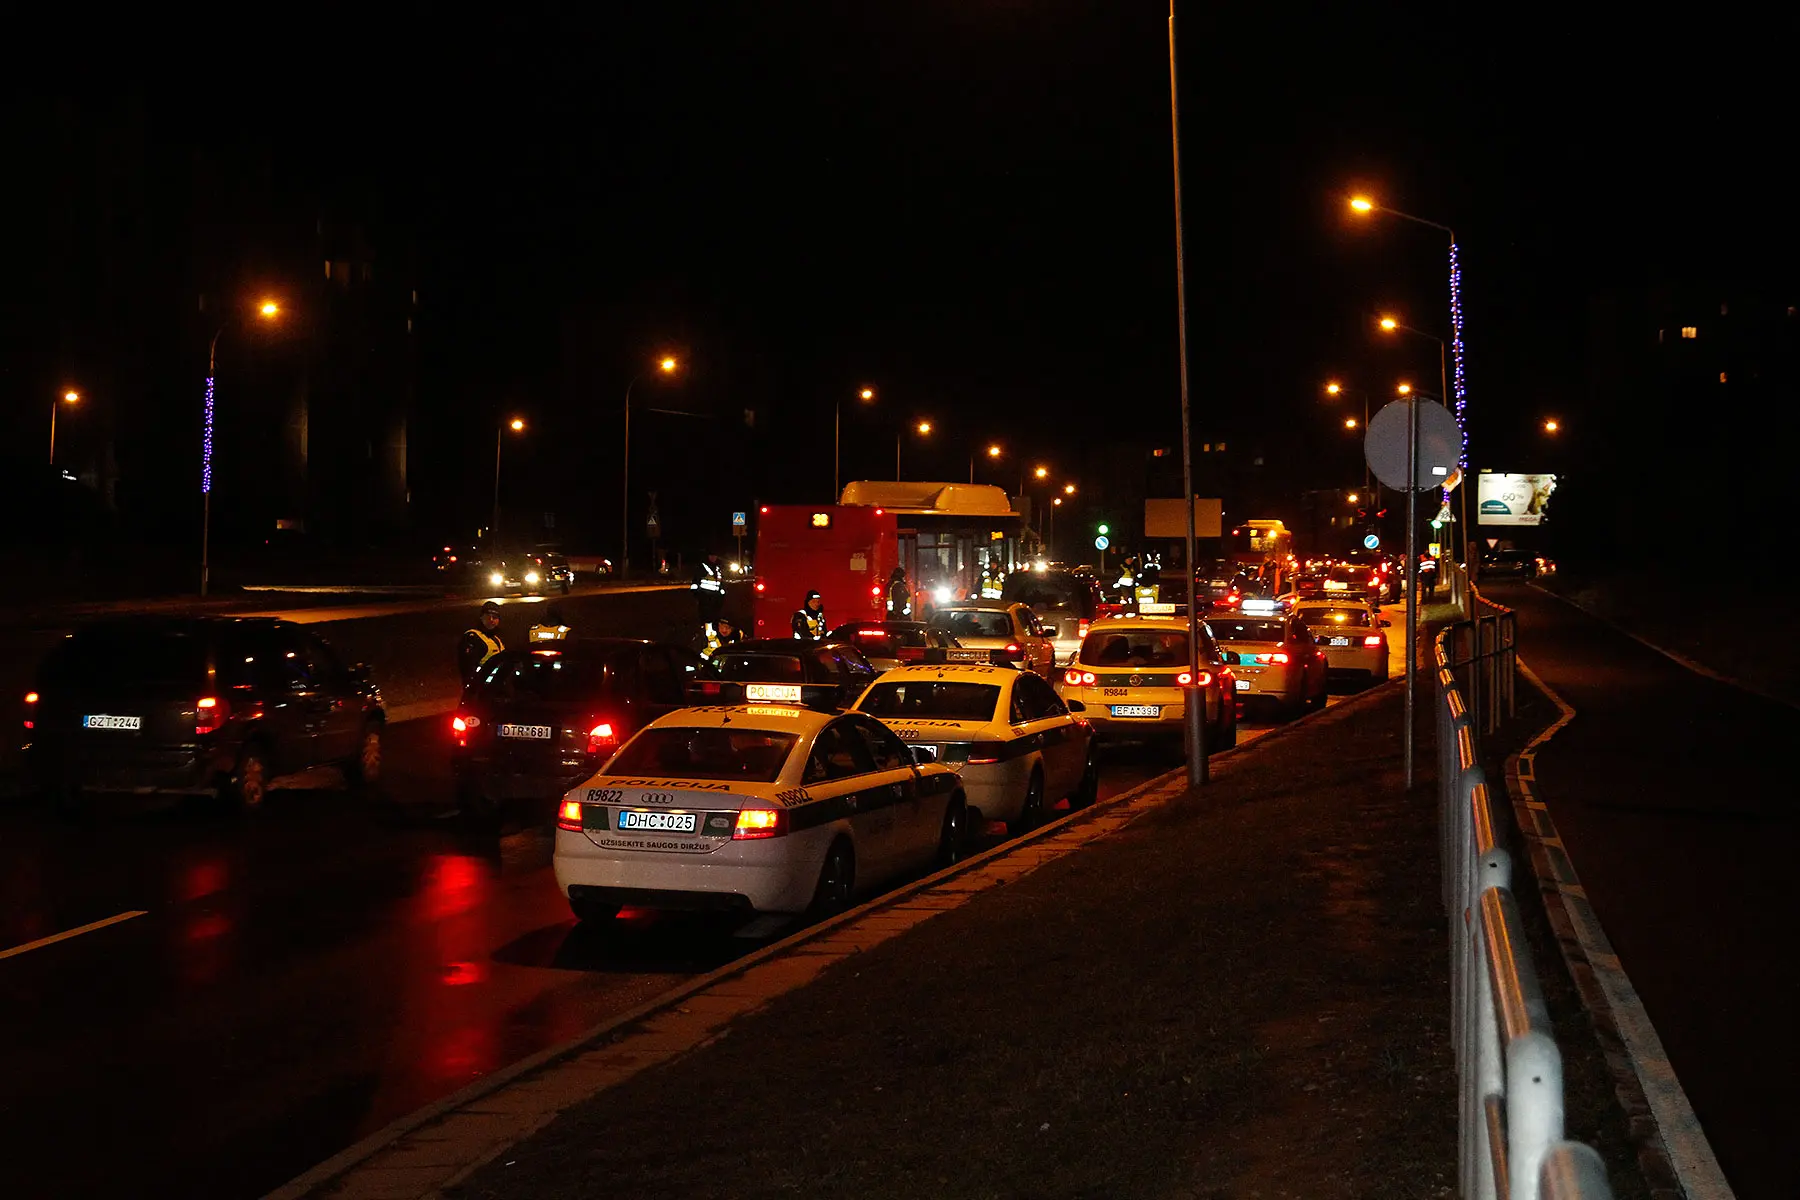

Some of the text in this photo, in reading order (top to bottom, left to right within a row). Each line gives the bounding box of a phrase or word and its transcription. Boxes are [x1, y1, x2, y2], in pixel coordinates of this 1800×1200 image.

[949, 651, 990, 659] POLICIJA
[751, 686, 797, 698] POLICIJA
[1103, 688, 1128, 697] R9844
[882, 720, 961, 728] OLICIJA
[607, 779, 730, 791] POLICIJA
[586, 789, 623, 803] R9822
[775, 786, 814, 807] R9822
